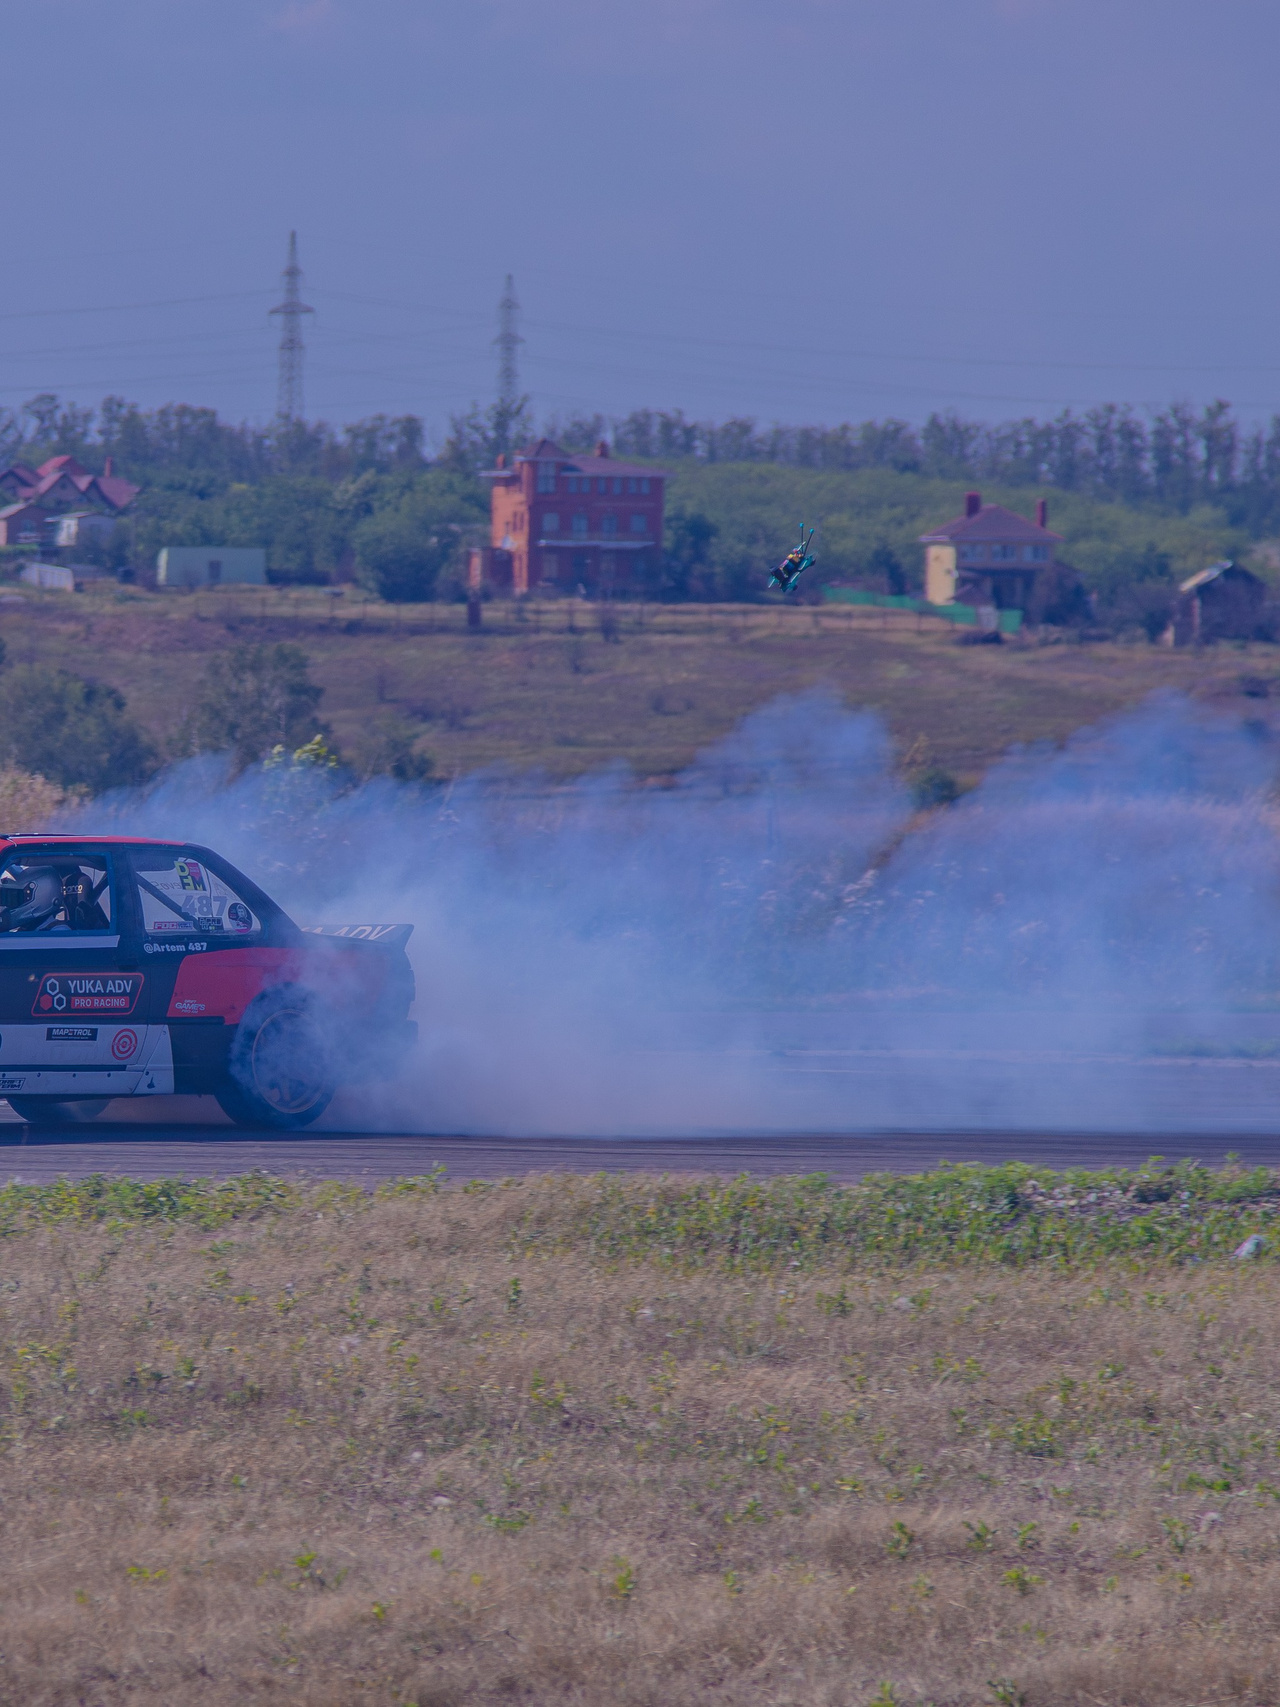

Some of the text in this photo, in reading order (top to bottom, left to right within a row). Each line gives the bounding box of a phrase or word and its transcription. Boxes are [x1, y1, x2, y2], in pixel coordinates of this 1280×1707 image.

[181, 895, 228, 917] 487
[143, 942, 208, 953] @Artem 487
[67, 980, 133, 993] YUKA ADV
[74, 998, 126, 1007] PRO RACING
